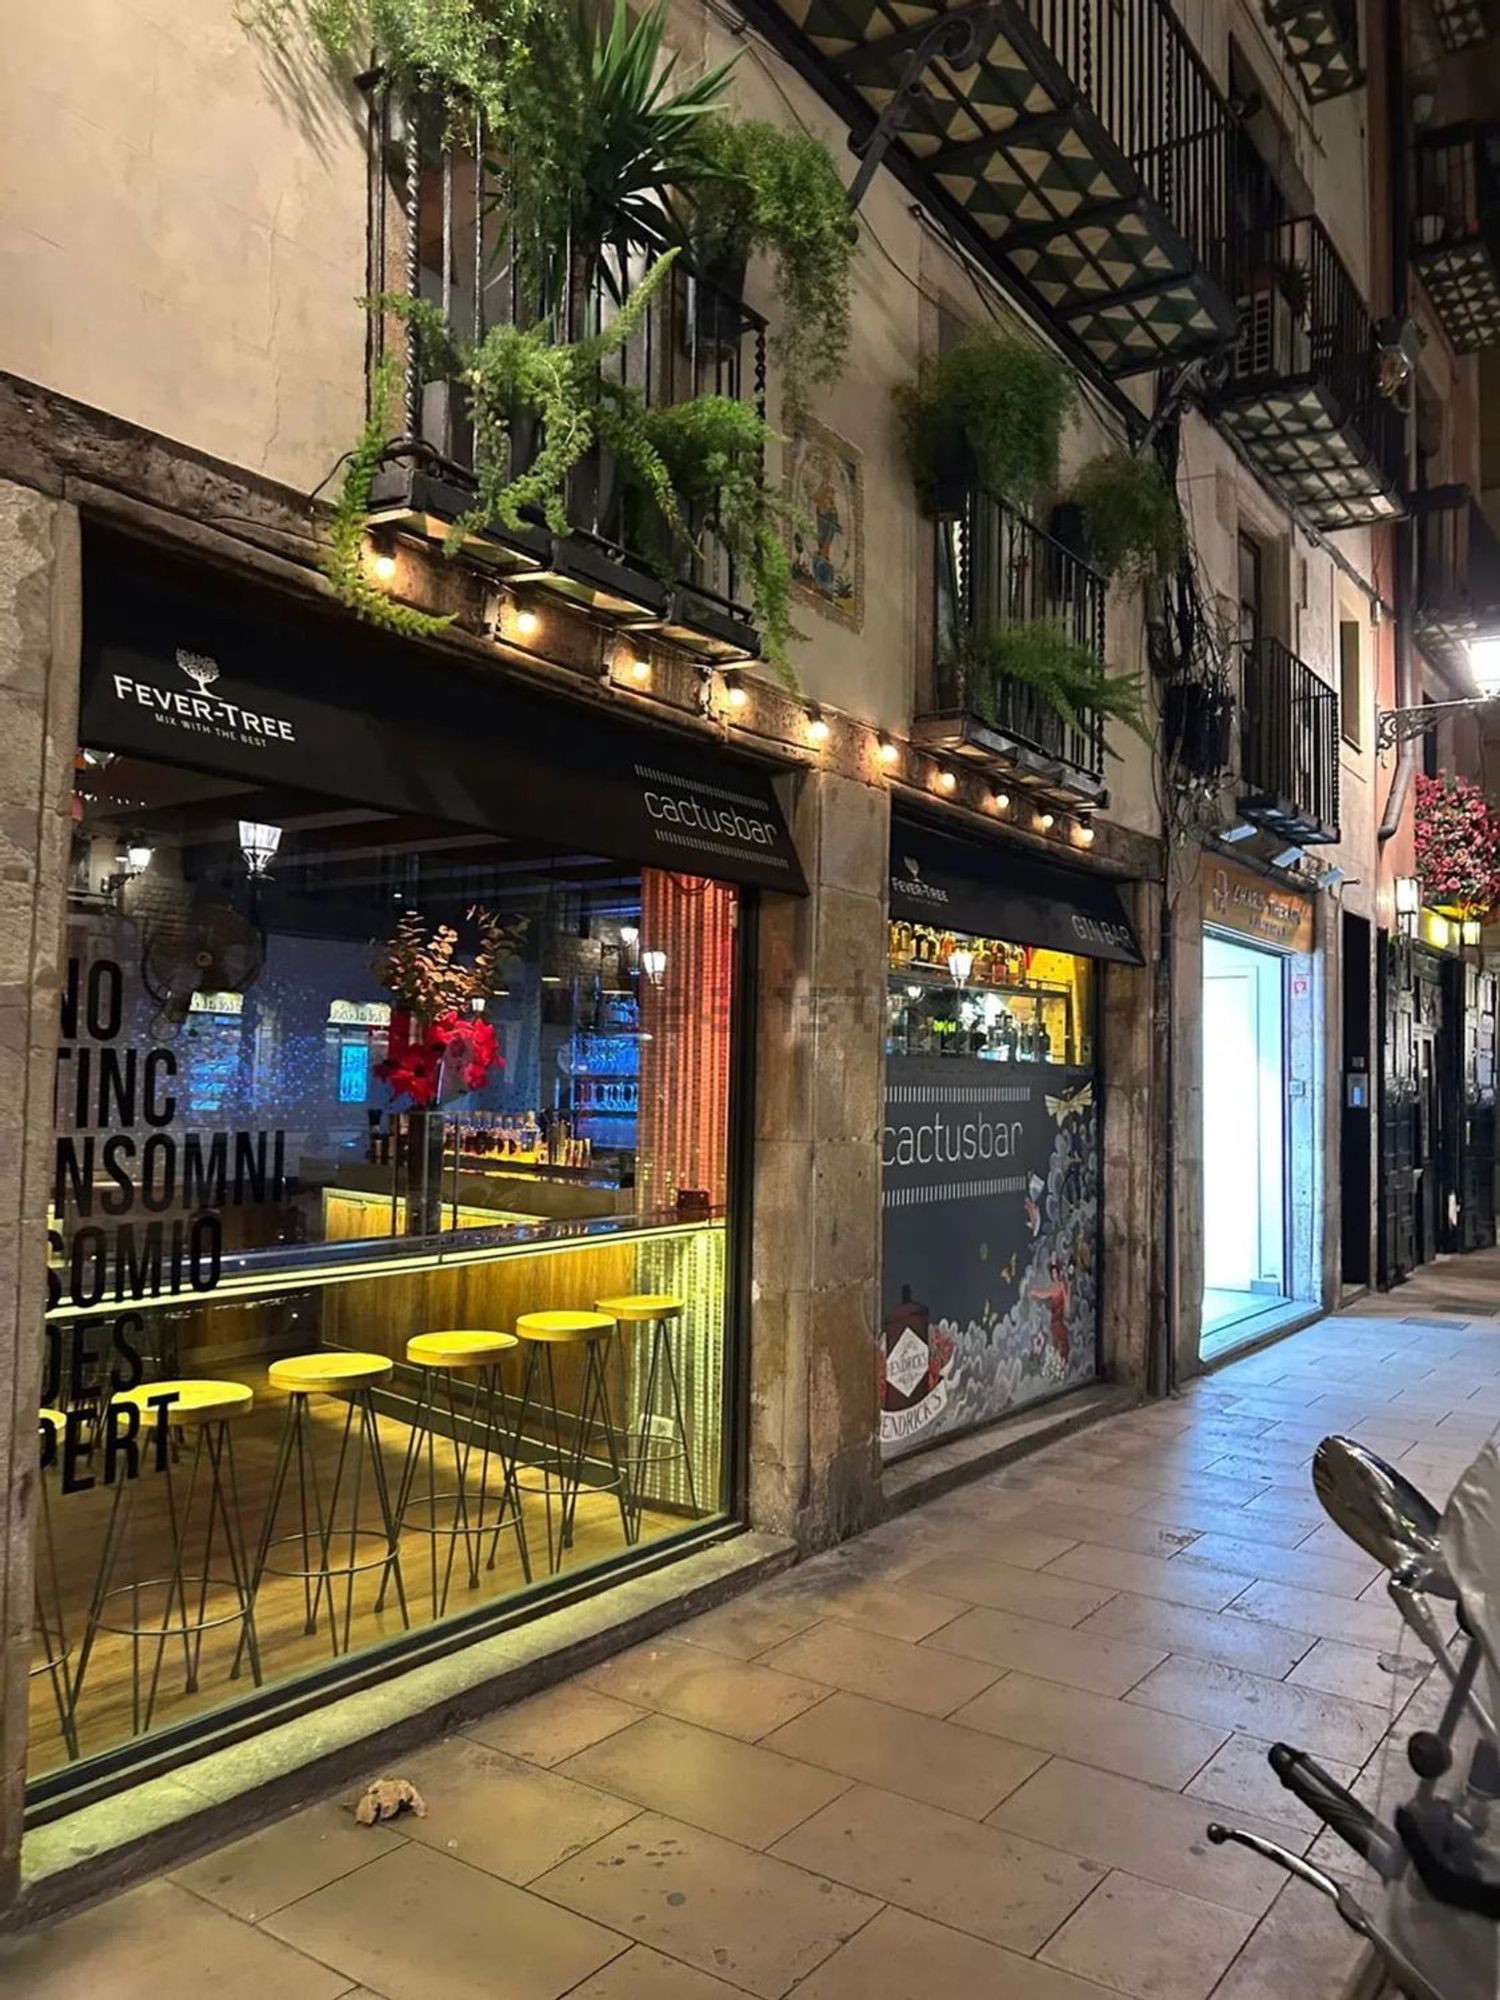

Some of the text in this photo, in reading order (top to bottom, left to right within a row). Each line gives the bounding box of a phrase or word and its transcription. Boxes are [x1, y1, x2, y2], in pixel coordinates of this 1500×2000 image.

[113, 674, 296, 742] FEVER-TREE
[155, 713, 267, 748] MIX WITH THE BEST
[643, 790, 778, 846] cactusbar
[881, 1111, 1024, 1166] cactusbar
[55, 1129, 285, 1219] NSOMNI
